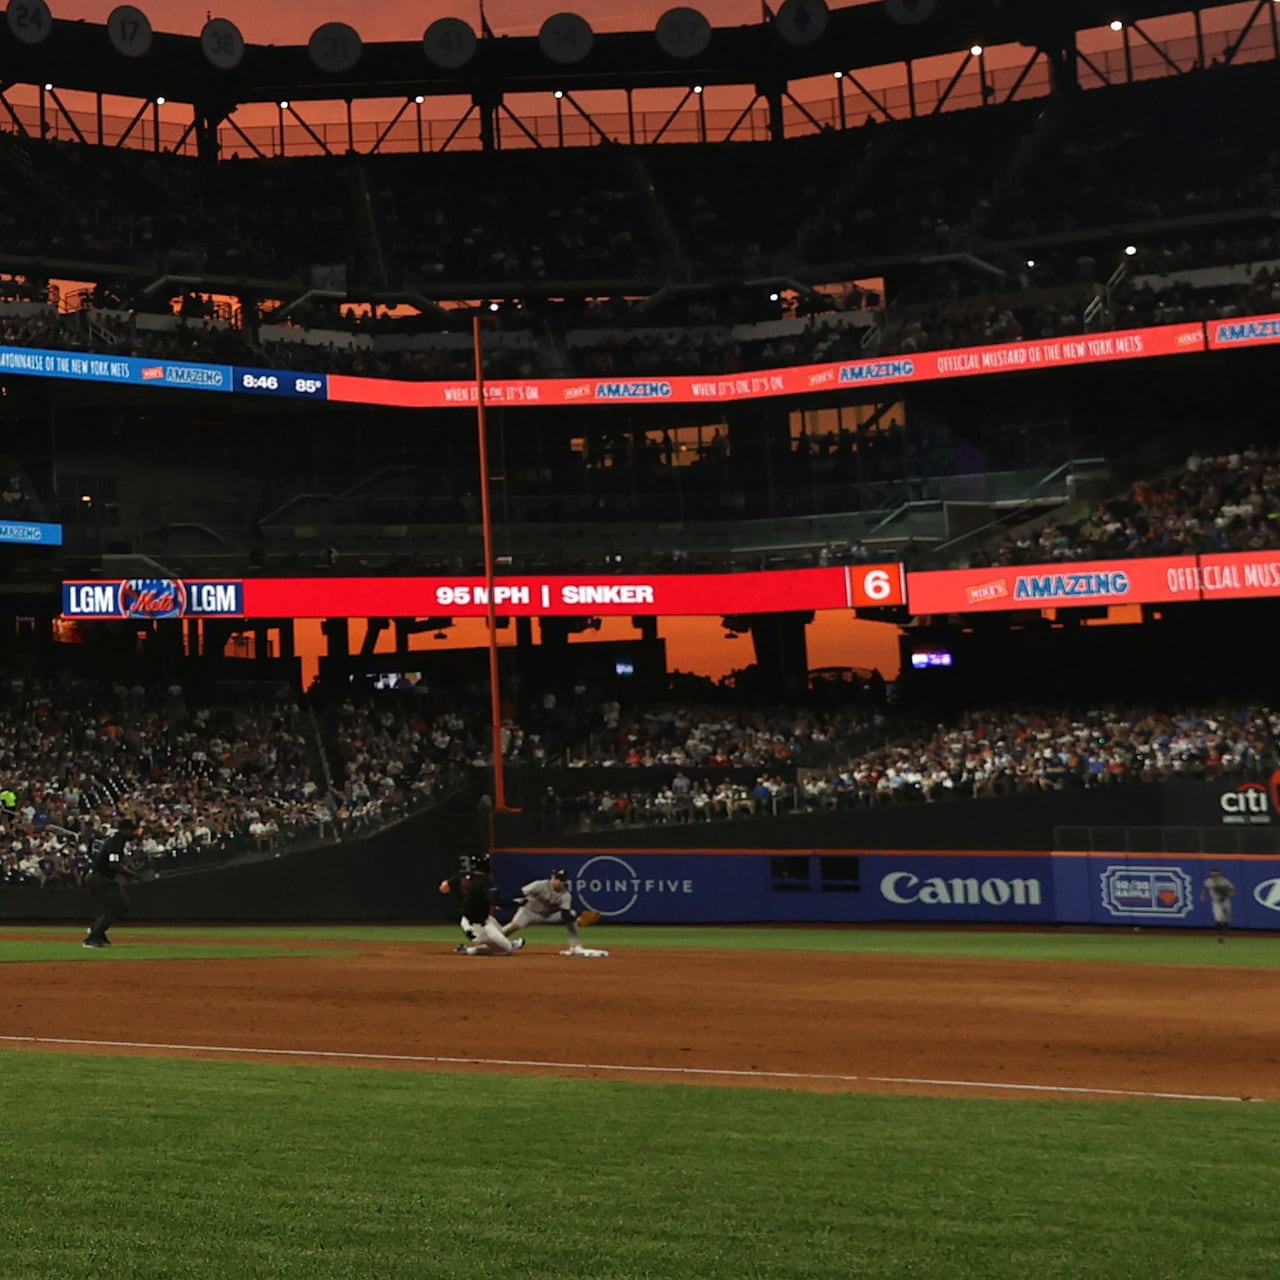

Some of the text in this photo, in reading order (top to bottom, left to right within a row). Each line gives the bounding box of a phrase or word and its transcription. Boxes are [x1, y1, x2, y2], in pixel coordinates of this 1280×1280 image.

[16, 6, 43, 30] 24
[120, 20, 139, 43] 17
[937, 335, 1142, 372] OFFICIAL MUSTARD OF THE NEW YORK METS
[243, 375, 278, 390] 8:46
[839, 360, 914, 383] AMAZING
[596, 382, 672, 398] AMAZING
[864, 570, 891, 599] 6
[1013, 571, 1130, 601] AMAZING
[1167, 566, 1240, 592] OFFICIAL
[70, 584, 236, 612] LGM Mets LGM
[436, 585, 654, 605] 95 MPH SINKER
[970, 584, 1006, 599] MIKE'S
[1221, 787, 1268, 812] citi
[880, 872, 1042, 906] Canon
